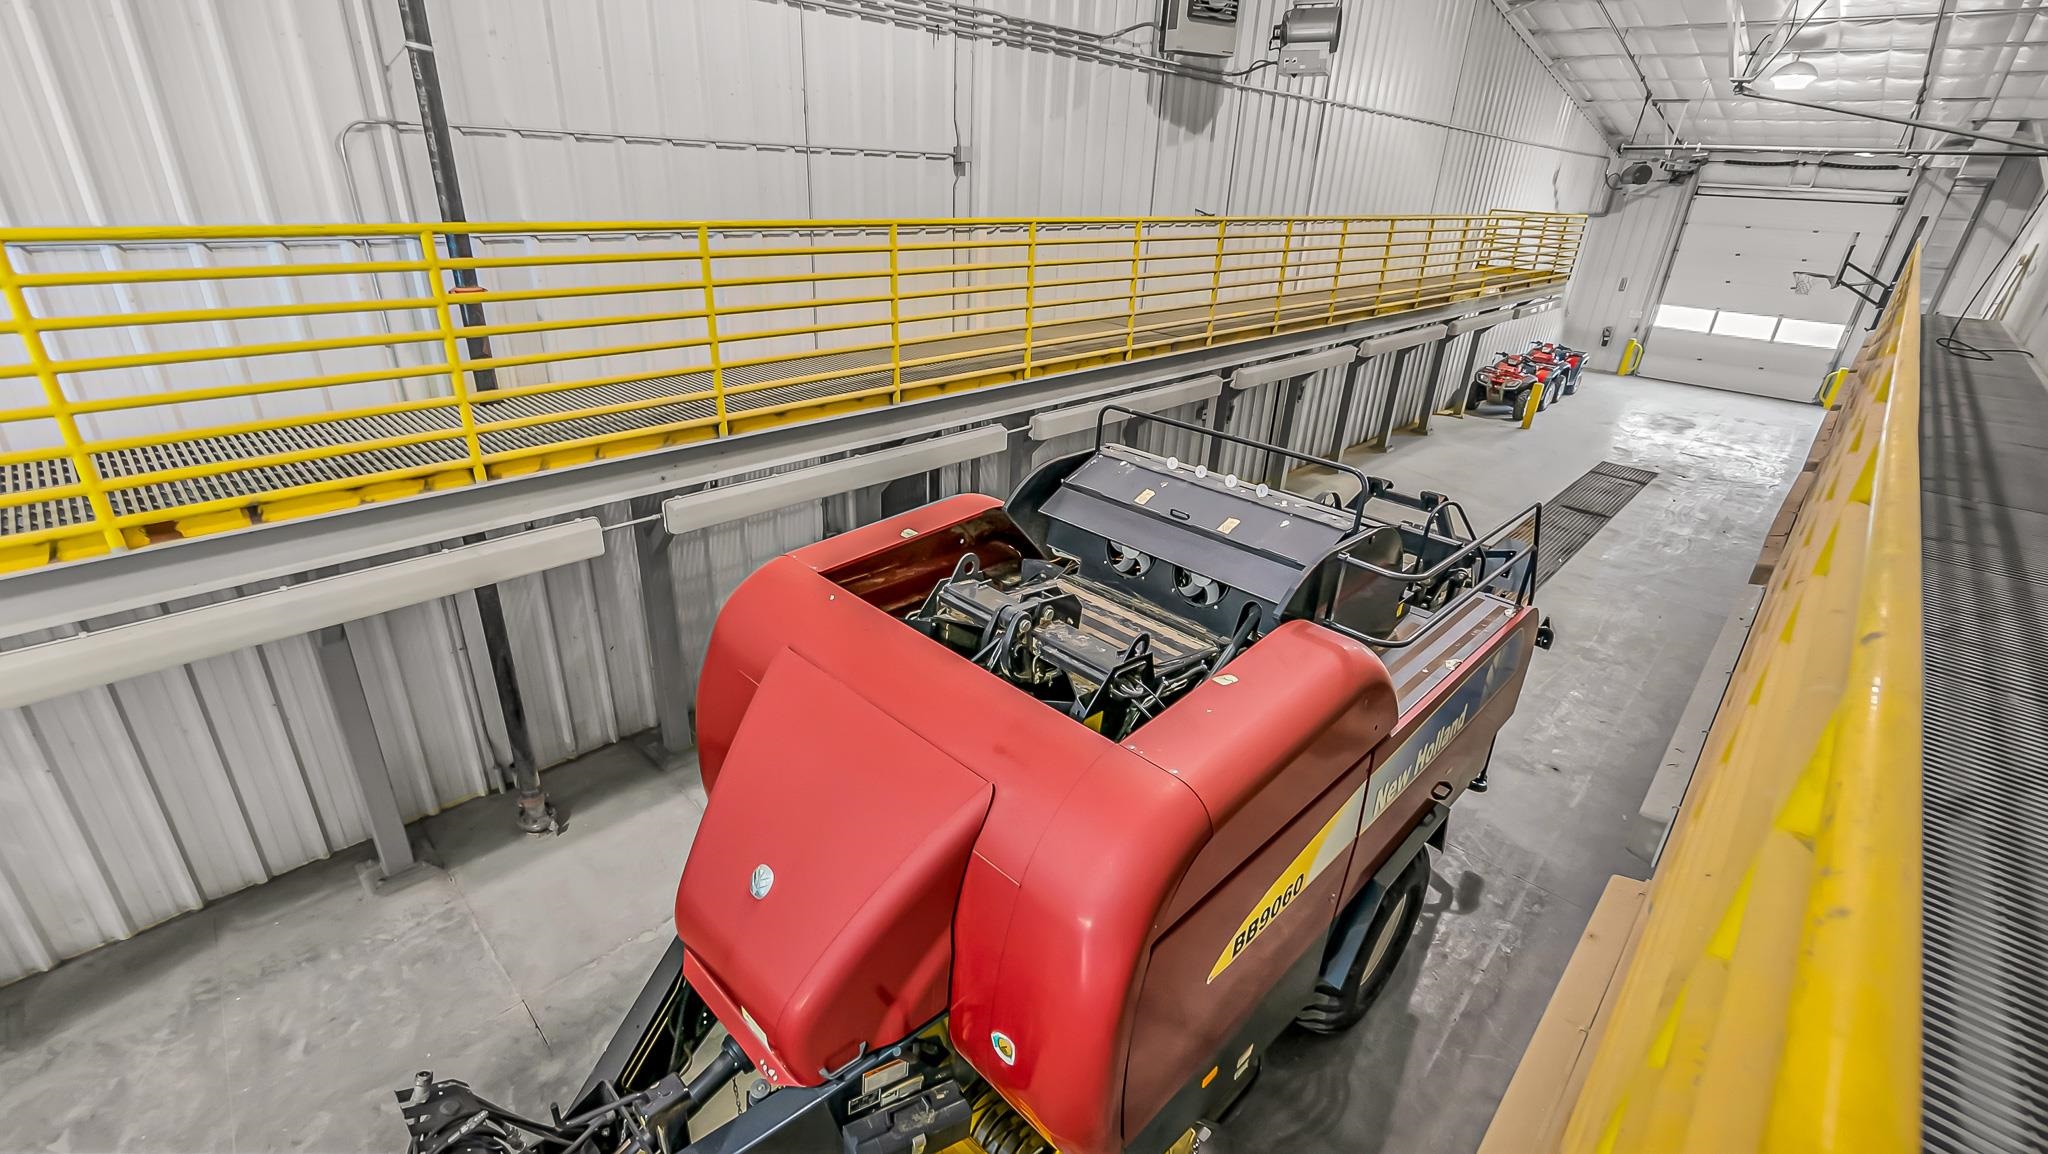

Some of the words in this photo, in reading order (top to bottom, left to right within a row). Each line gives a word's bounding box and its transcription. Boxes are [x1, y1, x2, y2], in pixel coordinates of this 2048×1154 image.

[1373, 764, 1412, 817] New
[1414, 703, 1468, 777] Holland
[1231, 873, 1304, 958] BB9060
